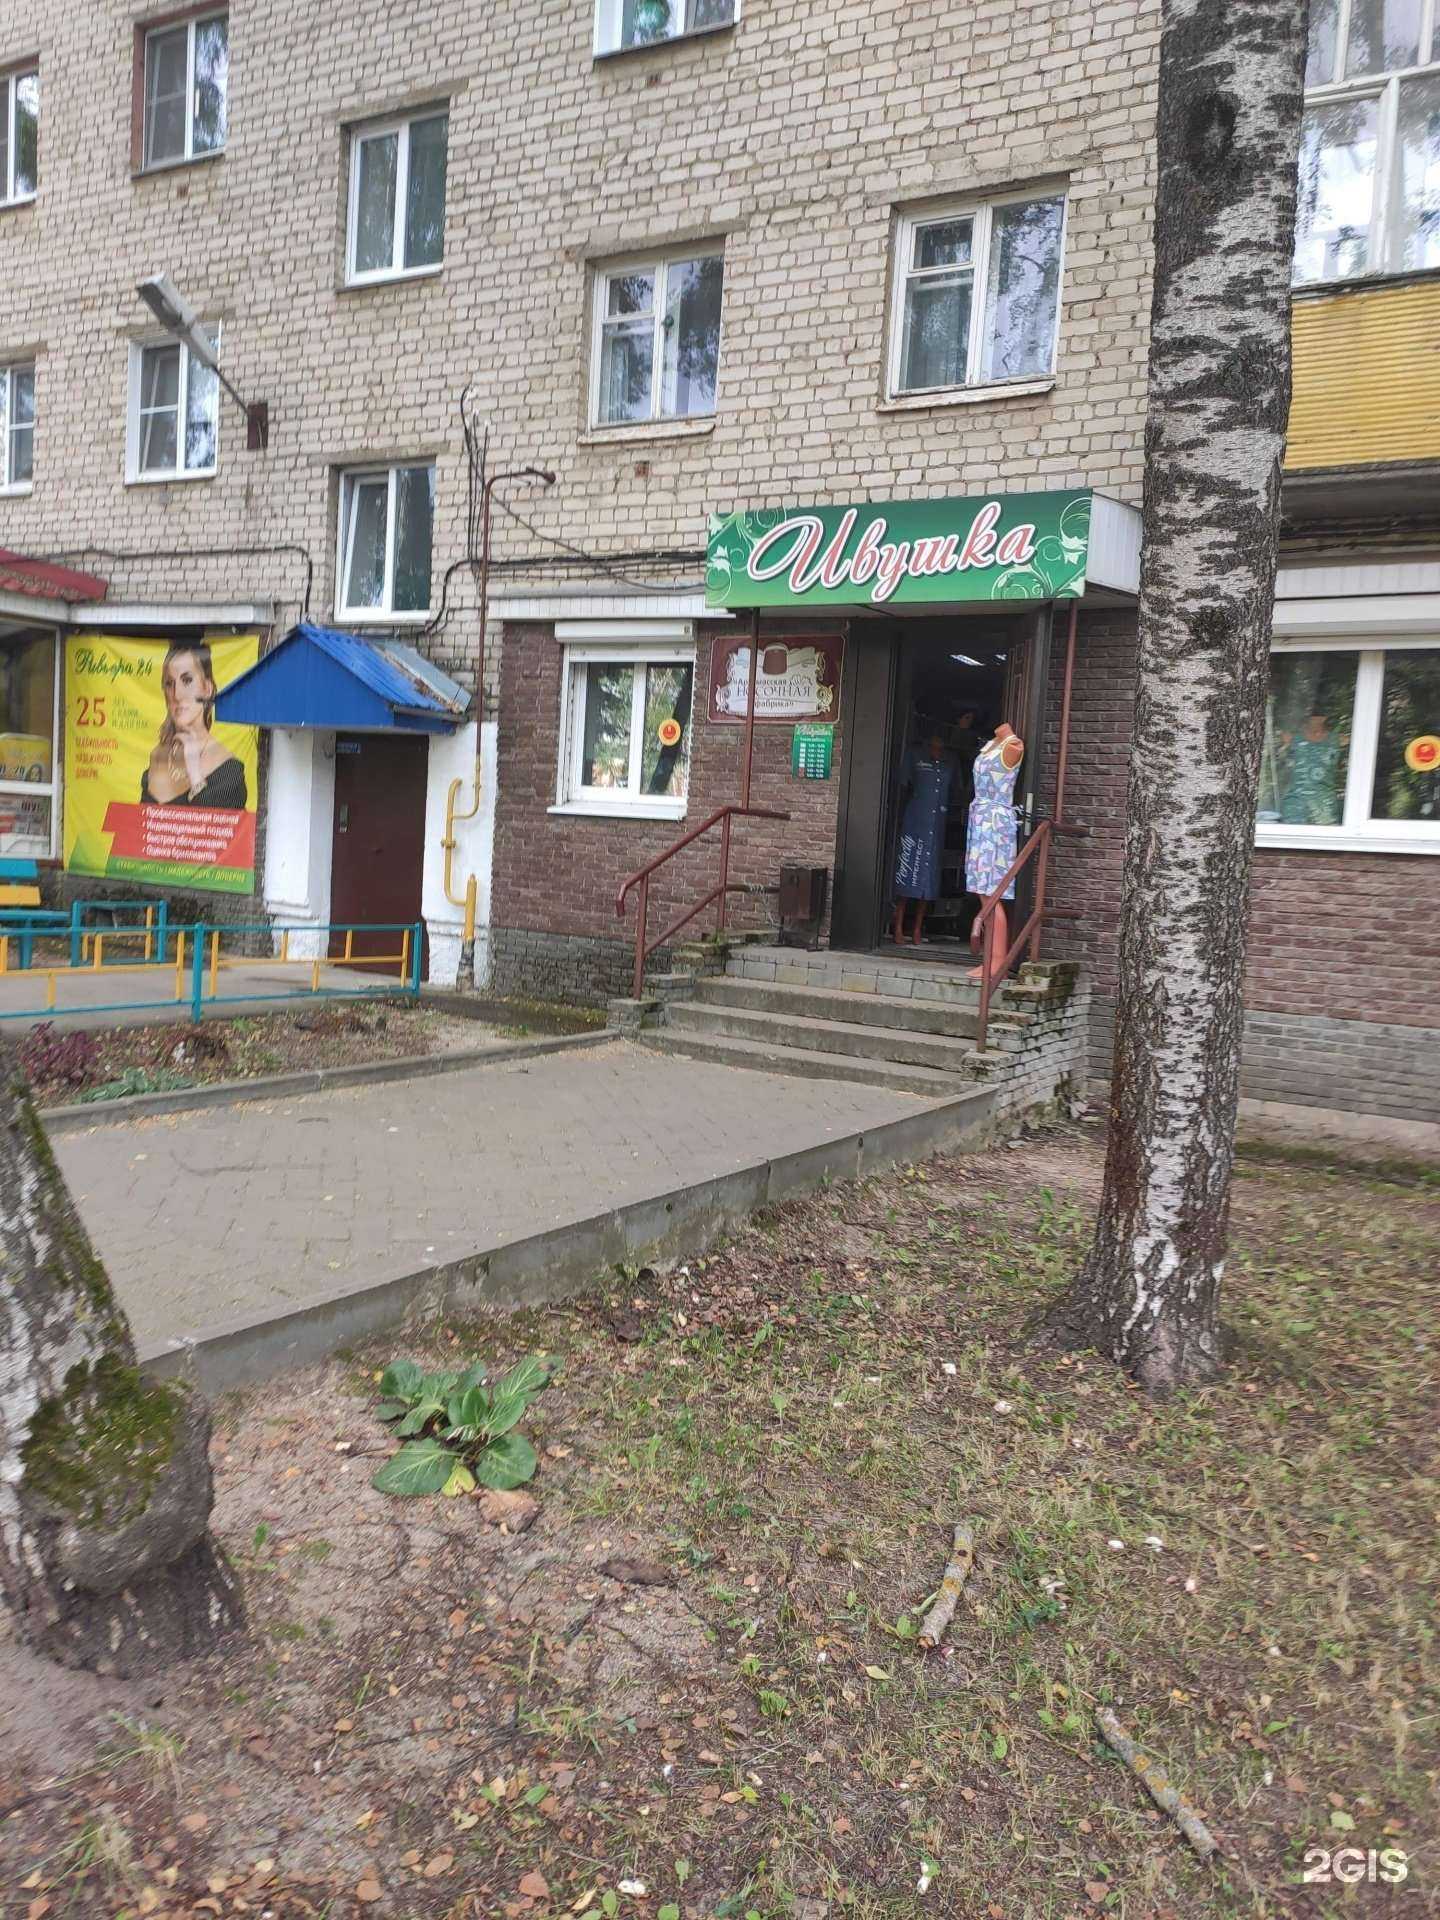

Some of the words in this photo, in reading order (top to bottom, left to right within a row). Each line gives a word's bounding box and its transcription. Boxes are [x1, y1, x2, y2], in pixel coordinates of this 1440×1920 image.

[747, 501, 1036, 602] Ивушка
[737, 686, 810, 697] НСОЧНАЯ
[76, 695, 106, 727] 25
